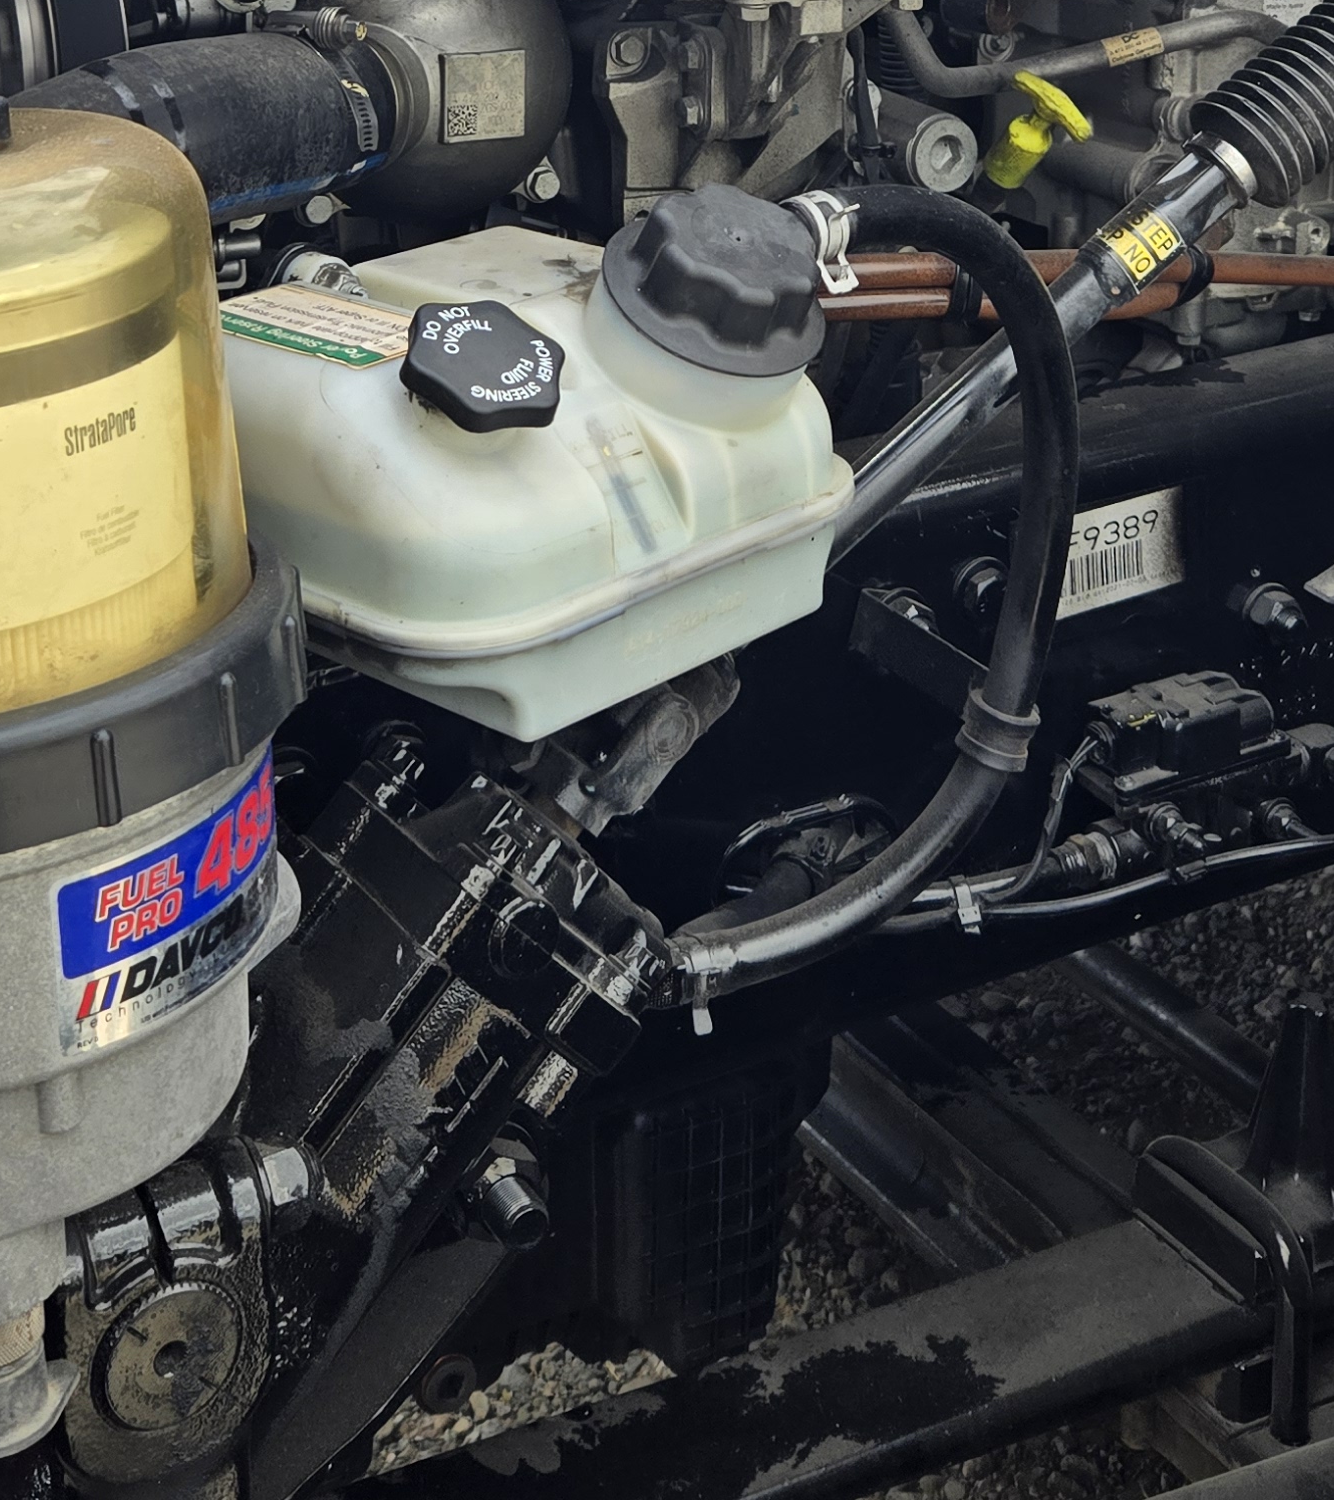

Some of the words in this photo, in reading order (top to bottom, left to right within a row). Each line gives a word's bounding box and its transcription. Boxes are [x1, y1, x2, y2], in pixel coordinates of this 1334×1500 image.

[1122, 32, 1139, 43] DC
[1130, 209, 1173, 250] STEP
[1123, 243, 1150, 273] NO
[266, 328, 323, 348] Steering
[422, 321, 441, 340] DO
[438, 306, 470, 321] NOT
[443, 320, 492, 354] OVERFILL
[501, 358, 534, 384] FLUID
[530, 340, 553, 382] POWER
[470, 381, 542, 402] STEERING
[64, 407, 136, 456] StrataPore
[95, 853, 185, 922] FUEL
[193, 762, 273, 899] 485
[107, 887, 183, 952] PRO
[120, 893, 244, 1003] DAYCO
[77, 972, 197, 1034] Technology
